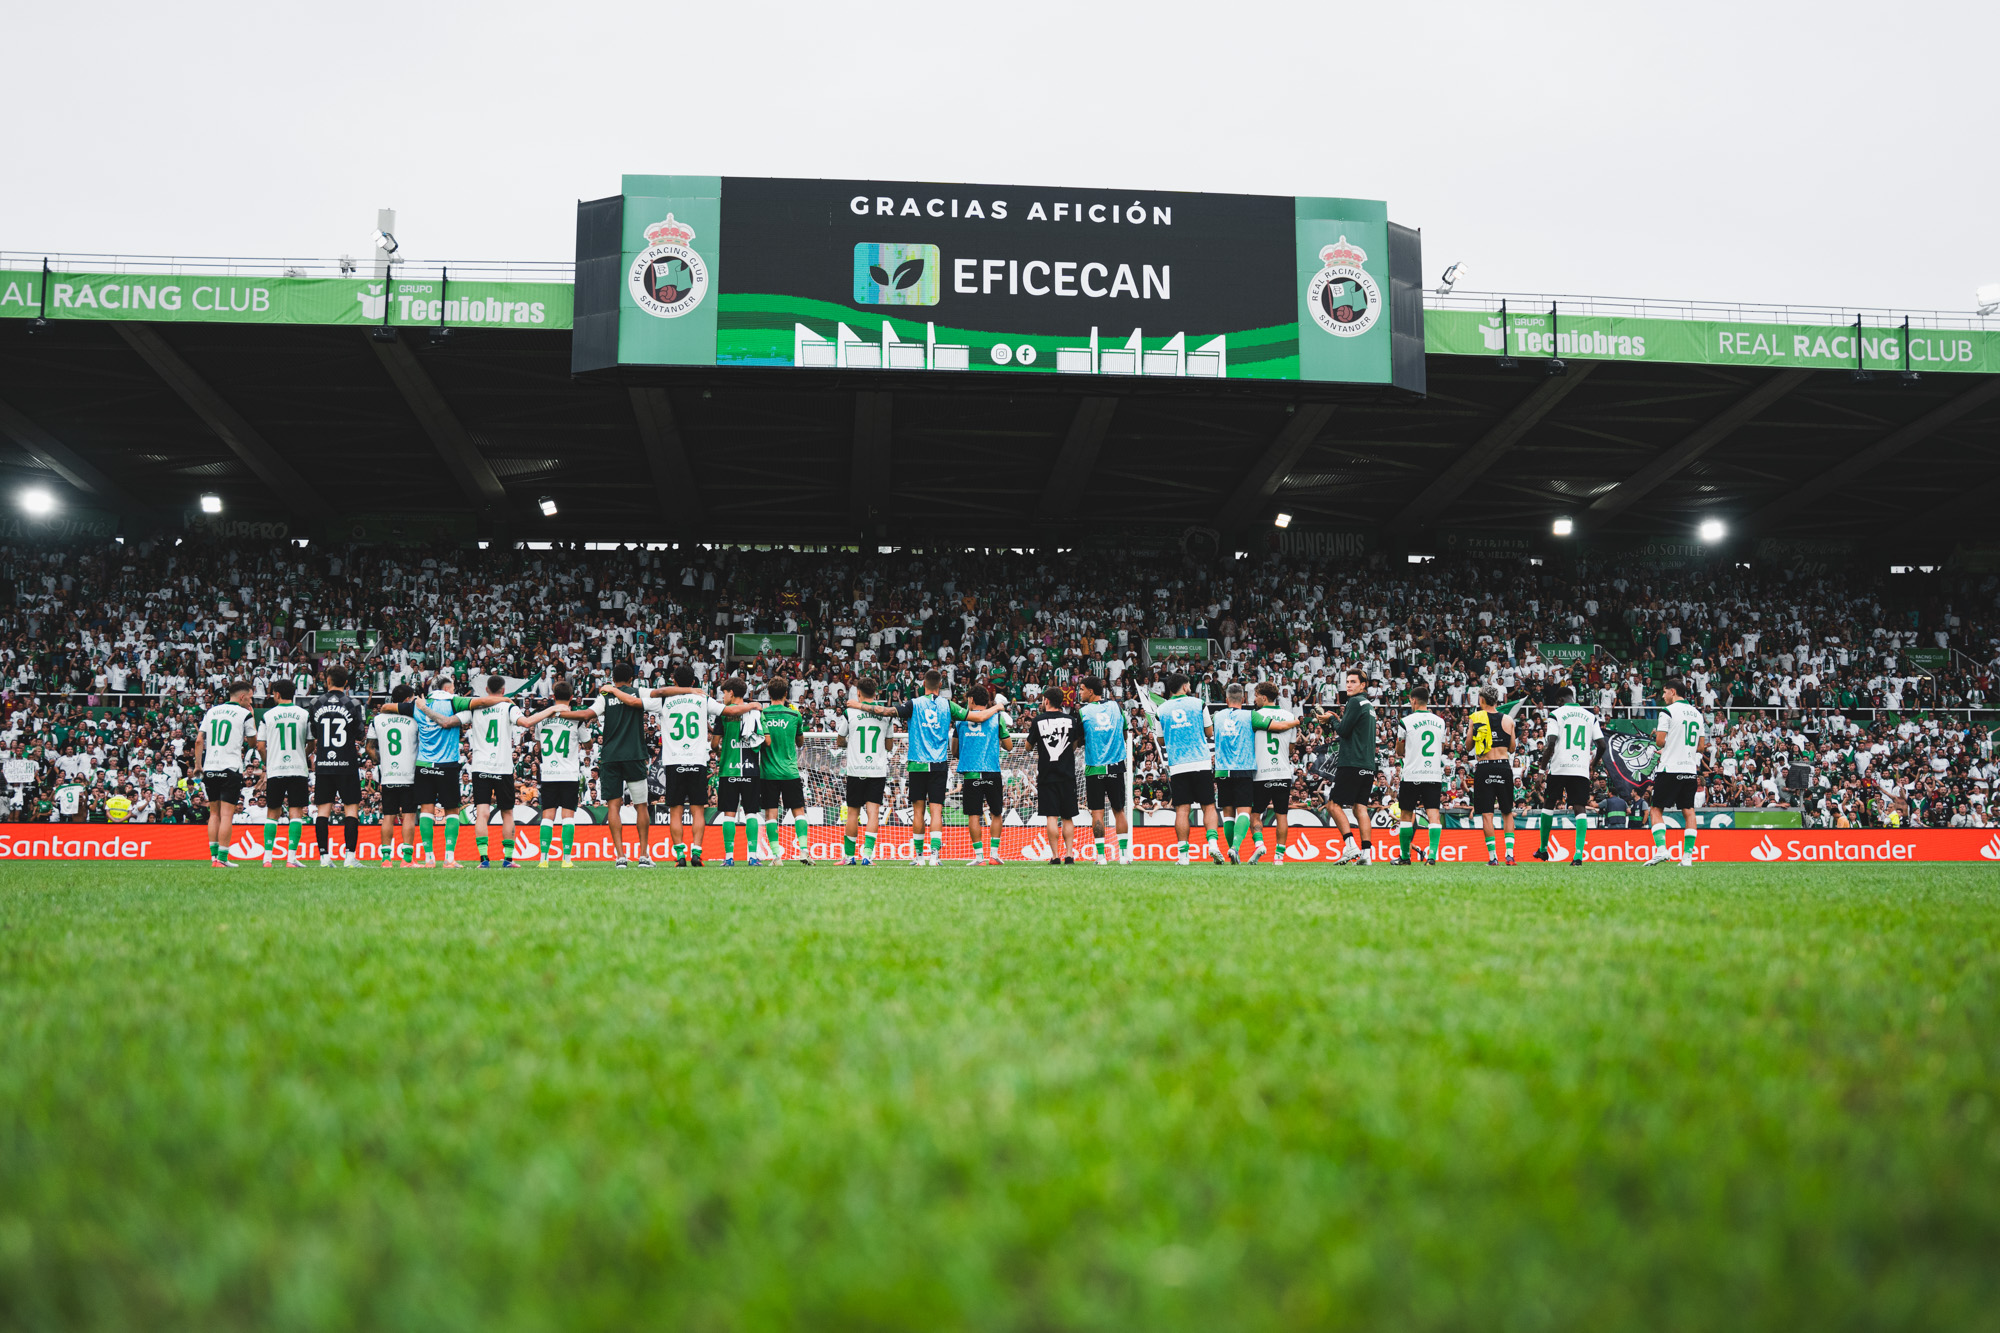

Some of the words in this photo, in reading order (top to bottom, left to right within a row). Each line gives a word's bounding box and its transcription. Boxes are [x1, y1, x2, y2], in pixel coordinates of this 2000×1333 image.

[850, 195, 1008, 220] GRACIAS
[1026, 200, 1172, 226] AFICIÓN
[634, 259, 648, 282] REAL
[649, 246, 688, 259] RACING
[689, 257, 704, 283] CLUB
[399, 284, 433, 294] GRUPO
[954, 258, 1171, 300] EFICECAN
[1311, 279, 1325, 301] REAL
[1324, 268, 1361, 279] RACING
[1362, 279, 1377, 304] CLUB
[53, 283, 182, 311] RACING
[192, 287, 270, 312] CLUB
[398, 295, 545, 323] Tecniobras
[640, 295, 696, 313] SANTANDER
[1319, 314, 1371, 332] SANTANDER
[1514, 318, 1545, 327] GRUPO
[1515, 328, 1645, 357] Tecniobras
[1719, 332, 1785, 356] REAL
[1793, 334, 1899, 361] RACING
[1909, 339, 1973, 362] CLUB
[1558, 649, 1586, 658] DIARIO
[213, 709, 239, 718] VICENTE
[273, 712, 301, 721] ANDRÉS
[666, 698, 687, 710] SERGIO
[210, 718, 232, 747] 10
[320, 717, 347, 748] 13
[387, 716, 411, 726] PUERTA
[485, 718, 499, 747] 4
[669, 711, 700, 741] 36
[765, 719, 789, 729] abify
[1413, 719, 1442, 730] MANTILLA
[1682, 719, 1700, 747] 16
[275, 722, 297, 751] 11
[386, 727, 402, 756] 8
[540, 728, 571, 758] 34
[856, 725, 882, 754] 17
[1266, 730, 1280, 755] 5
[1421, 730, 1435, 757] 2
[1563, 723, 1586, 751] 14
[66, 792, 74, 803] 9
[0, 835, 152, 858] Santander
[546, 837, 700, 859] Sntadr
[1072, 839, 1216, 861] Sanander
[1325, 839, 1468, 861] Sntaer
[1786, 839, 1917, 861] Santander
